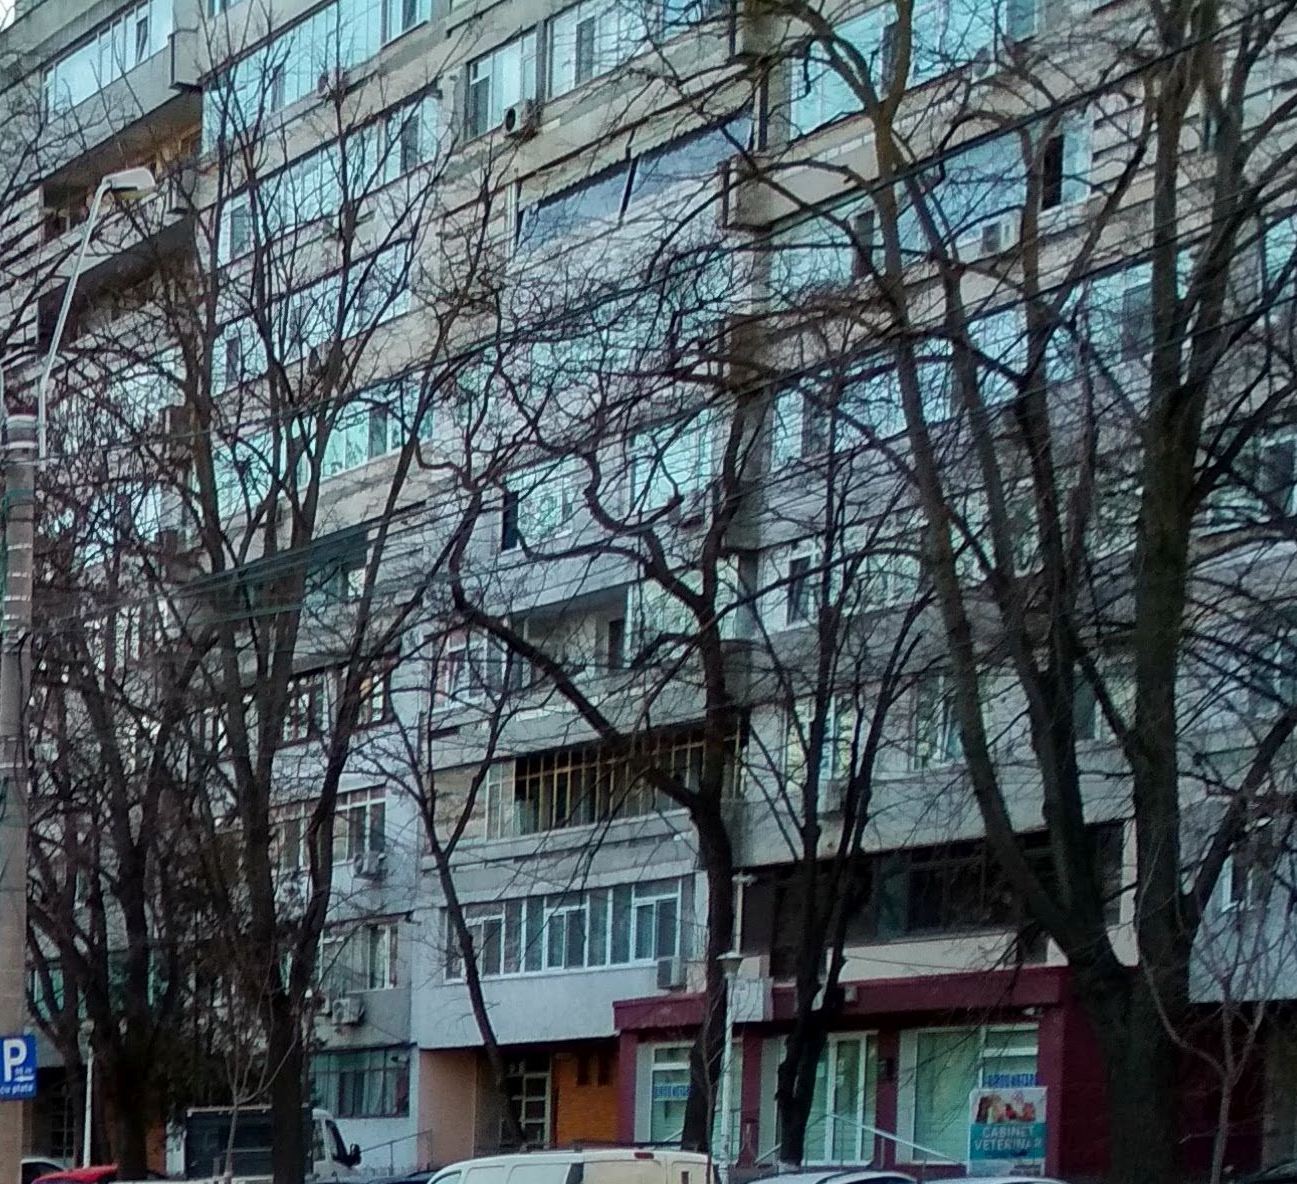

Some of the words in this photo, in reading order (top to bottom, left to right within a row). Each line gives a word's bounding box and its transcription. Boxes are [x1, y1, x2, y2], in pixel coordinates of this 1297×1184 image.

[3, 1039, 27, 1082] P
[982, 1126, 1034, 1138] CABINET
[974, 1138, 1042, 1152] VETERINAR
